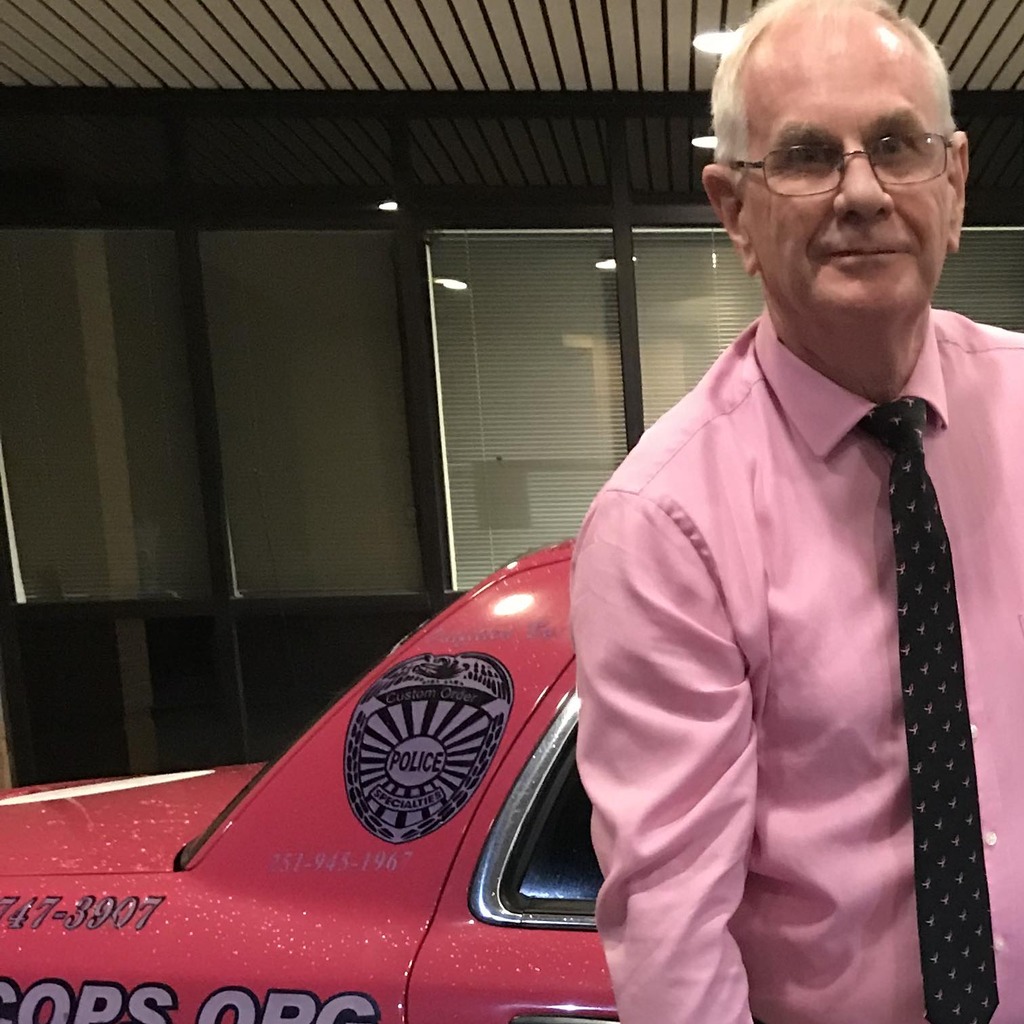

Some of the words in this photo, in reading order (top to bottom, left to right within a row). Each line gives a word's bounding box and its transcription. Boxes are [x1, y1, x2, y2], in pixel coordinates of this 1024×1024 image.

[386, 688, 437, 703] Custom
[440, 687, 478, 702] Order
[389, 751, 443, 773] POLICE
[373, 790, 443, 809] SPECIALTIES
